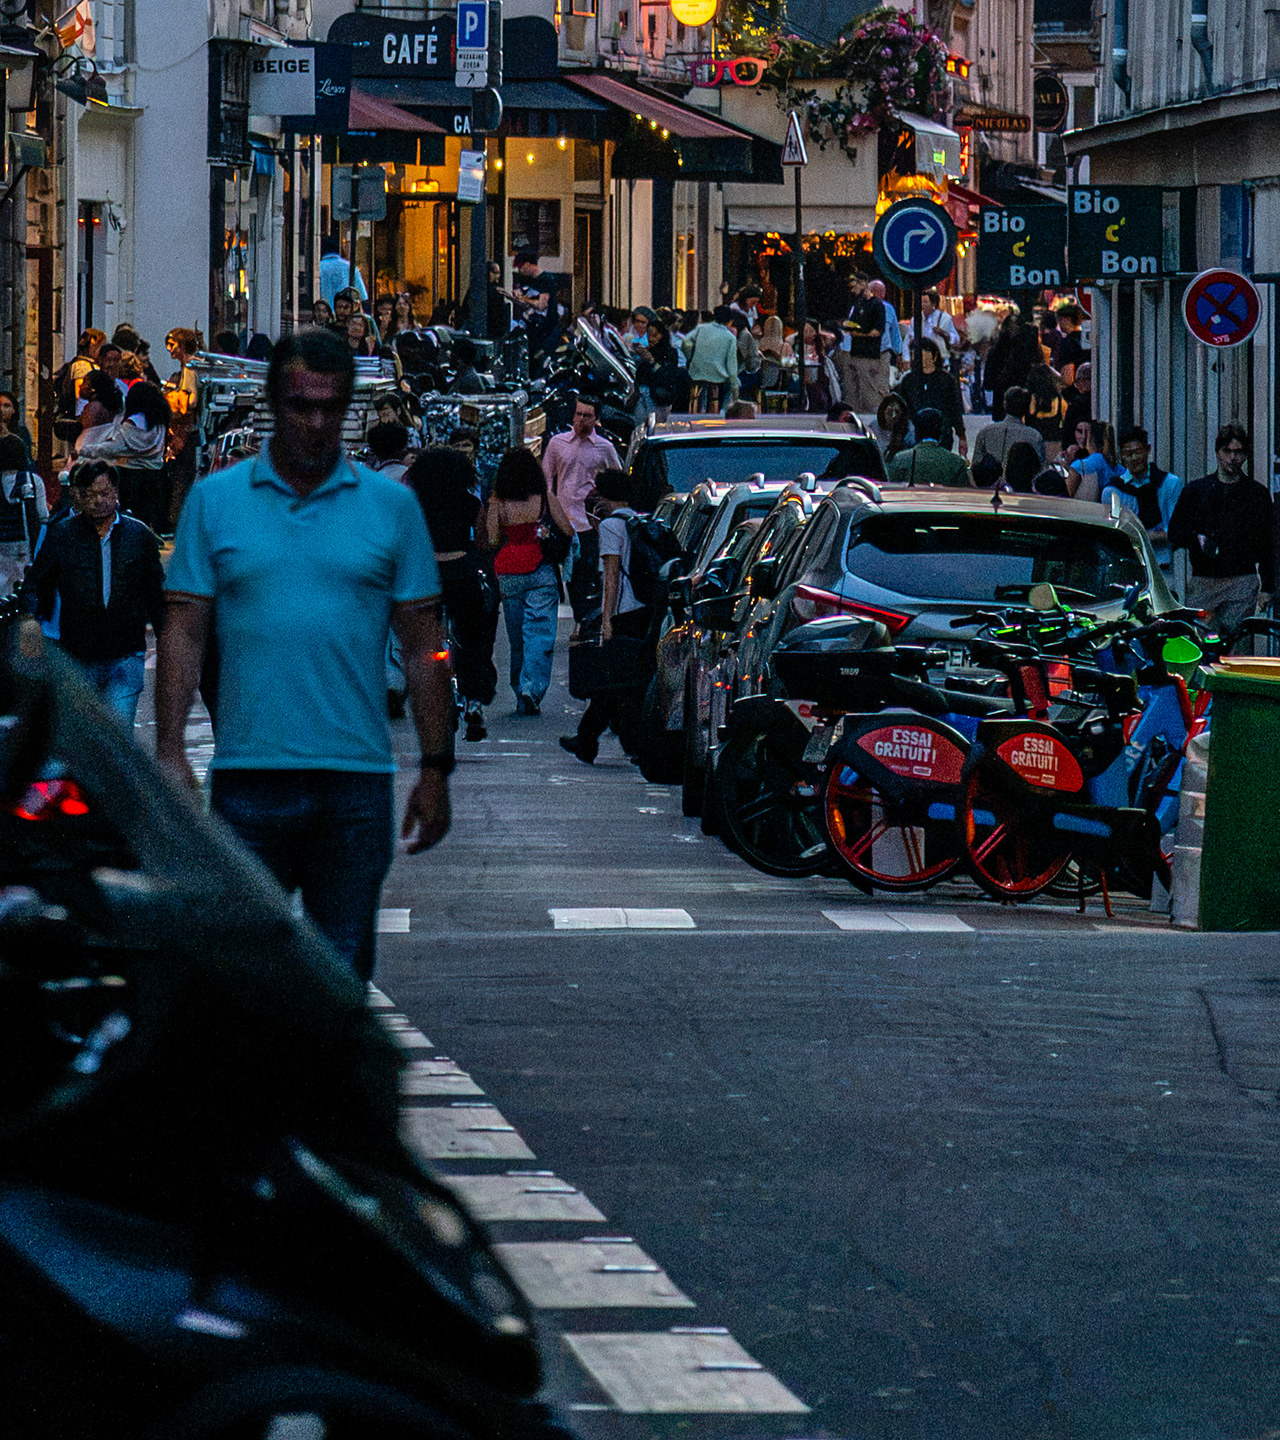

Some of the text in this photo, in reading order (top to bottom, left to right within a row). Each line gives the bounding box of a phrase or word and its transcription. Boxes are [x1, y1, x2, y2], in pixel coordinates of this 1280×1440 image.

[465, 10, 478, 40] P
[383, 25, 438, 64] CAFÉ
[253, 59, 310, 73] BEIGE
[1073, 189, 1120, 215] Bio
[983, 210, 1026, 233] Bio
[1101, 250, 1158, 275] Bon
[1009, 265, 1061, 286] Bon
[892, 728, 933, 746] ESSAI
[1023, 736, 1054, 755] ESSAI
